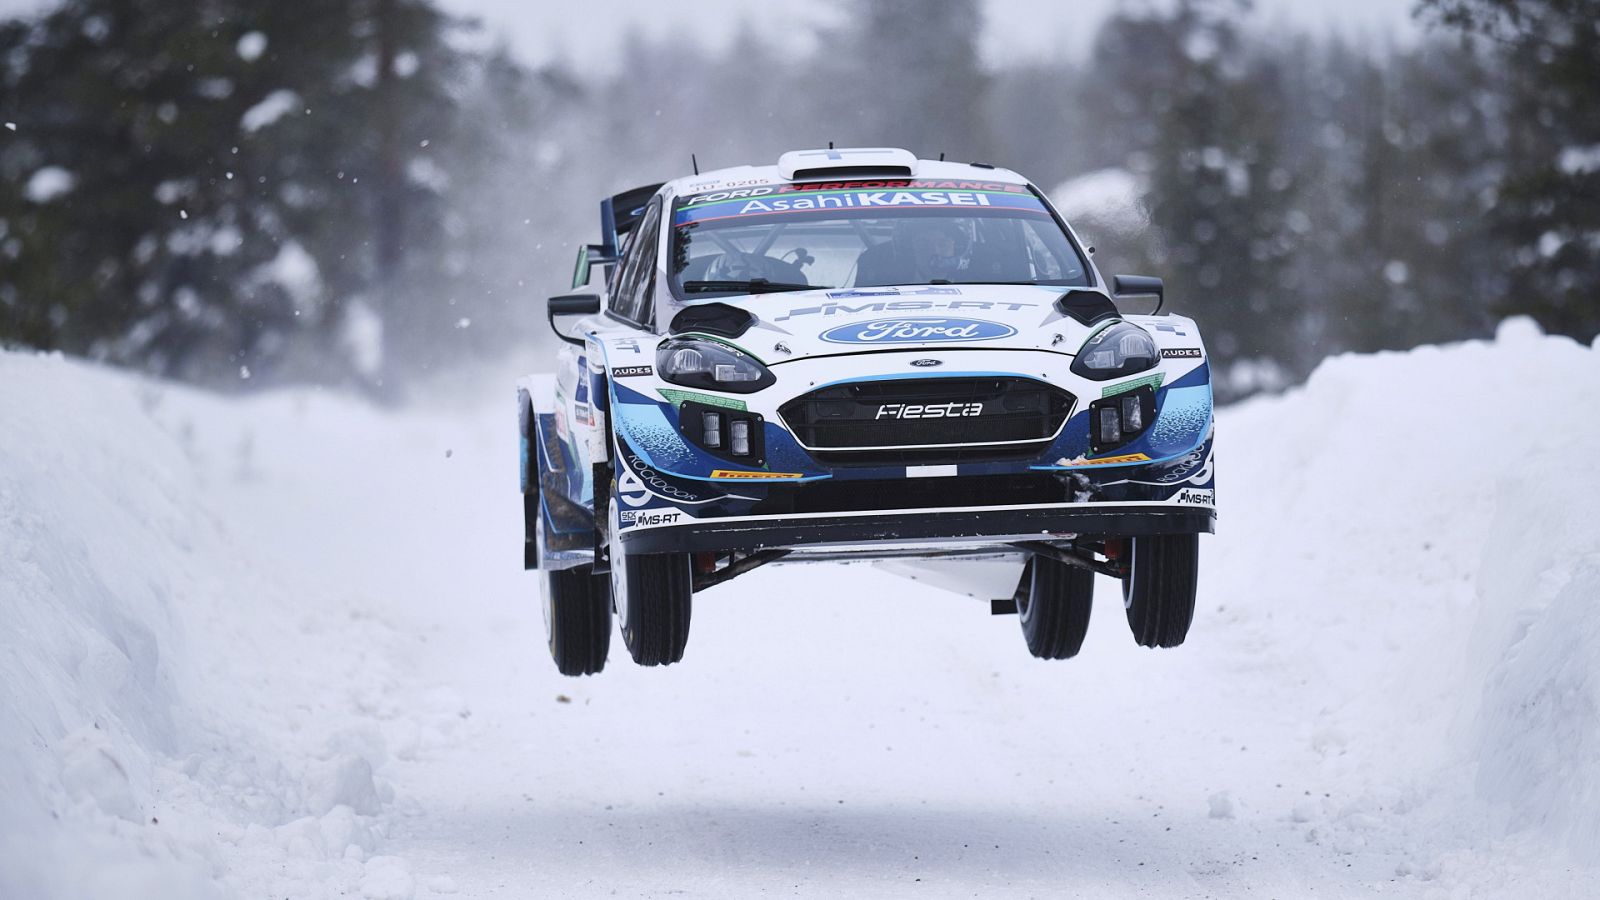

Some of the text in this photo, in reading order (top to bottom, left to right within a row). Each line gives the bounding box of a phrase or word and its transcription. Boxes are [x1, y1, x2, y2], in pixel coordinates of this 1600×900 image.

[687, 180, 1024, 206] FORD PERFORMANCE
[857, 319, 979, 341] Ford
[614, 367, 651, 375] AUDES
[915, 359, 937, 367] Ford
[875, 402, 983, 420] Fiesta
